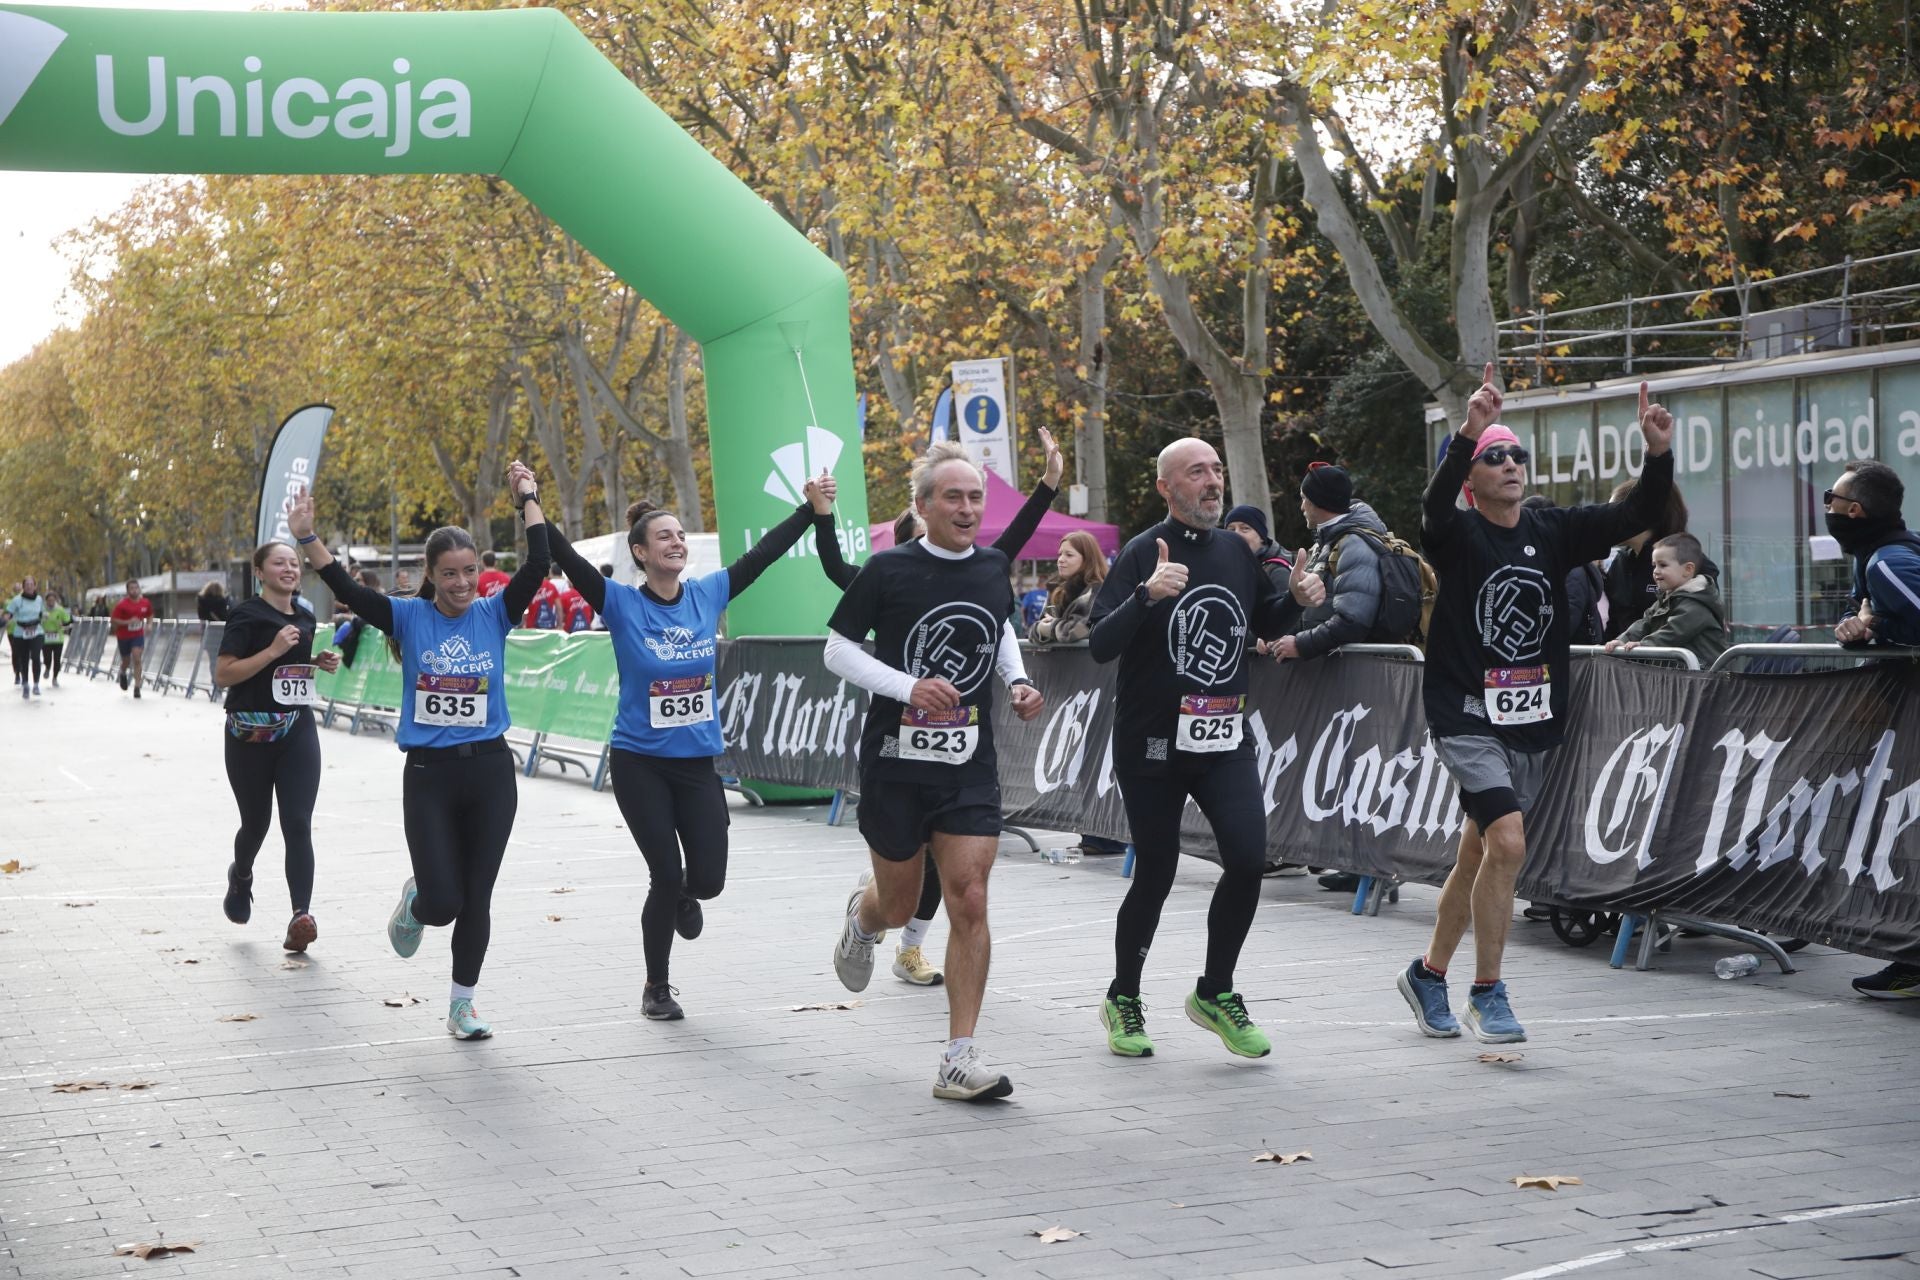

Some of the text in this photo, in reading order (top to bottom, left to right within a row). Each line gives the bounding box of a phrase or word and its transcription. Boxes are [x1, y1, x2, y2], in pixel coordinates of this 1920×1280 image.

[96, 54, 471, 158] Unicaja
[1524, 415, 1713, 485] LLADOID
[1732, 397, 1875, 470] ciudad
[270, 456, 309, 543] nicaja
[745, 519, 867, 564] caja
[1483, 583, 1496, 647] LINGOTES ESPECIALES
[1538, 604, 1553, 616] 968
[675, 647, 715, 660] ACEVES
[691, 638, 713, 649] GRUPO
[911, 623, 928, 678] GOTES ESPECIALES
[975, 642, 994, 654] 1968
[1176, 609, 1187, 675] LINGOTES ESPECIALES
[452, 659, 494, 674] ACEVES
[468, 650, 491, 662] GUPO
[281, 680, 307, 697] 973
[1496, 687, 1543, 713] 624
[425, 694, 475, 717] 635
[660, 694, 704, 718] 636
[762, 671, 856, 758] Norte
[1189, 716, 1235, 741] 625
[911, 729, 967, 754] 623
[1035, 687, 1101, 794] El
[1302, 702, 1467, 844] Casti
[1585, 722, 1920, 894] El Norte
